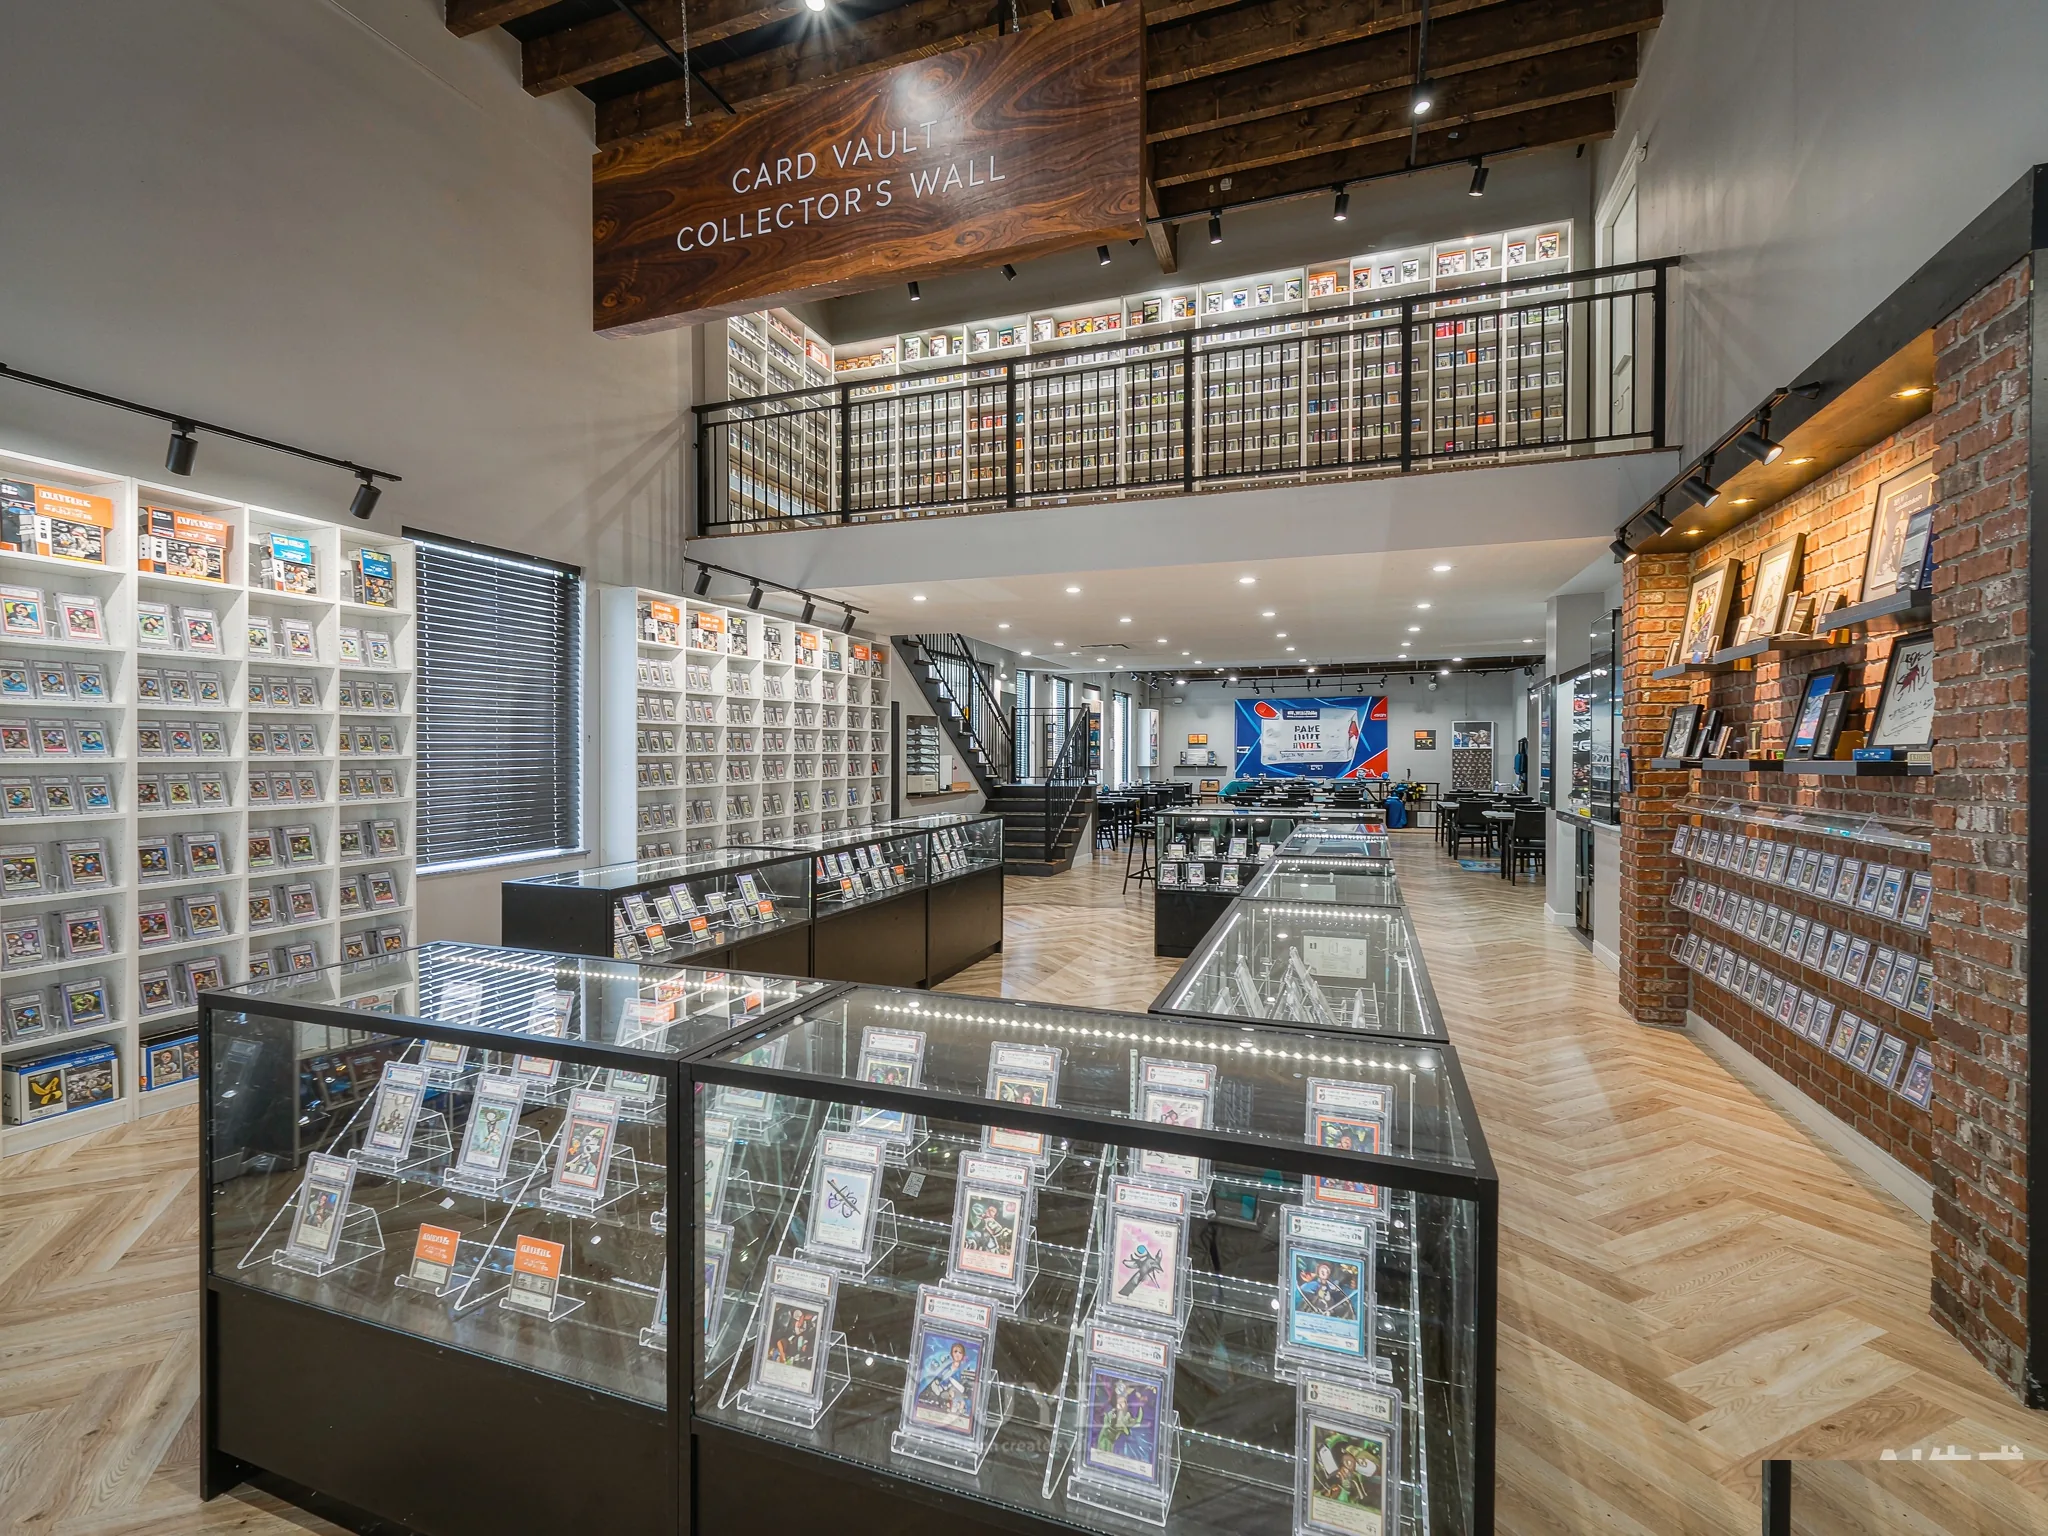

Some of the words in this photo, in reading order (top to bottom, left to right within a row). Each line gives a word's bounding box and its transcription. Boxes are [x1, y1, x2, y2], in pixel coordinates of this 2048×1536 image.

[732, 152, 817, 194] CARD
[832, 119, 939, 169] VAULT
[676, 179, 893, 252] COLLECTOR'S
[909, 155, 1007, 199] WALL
